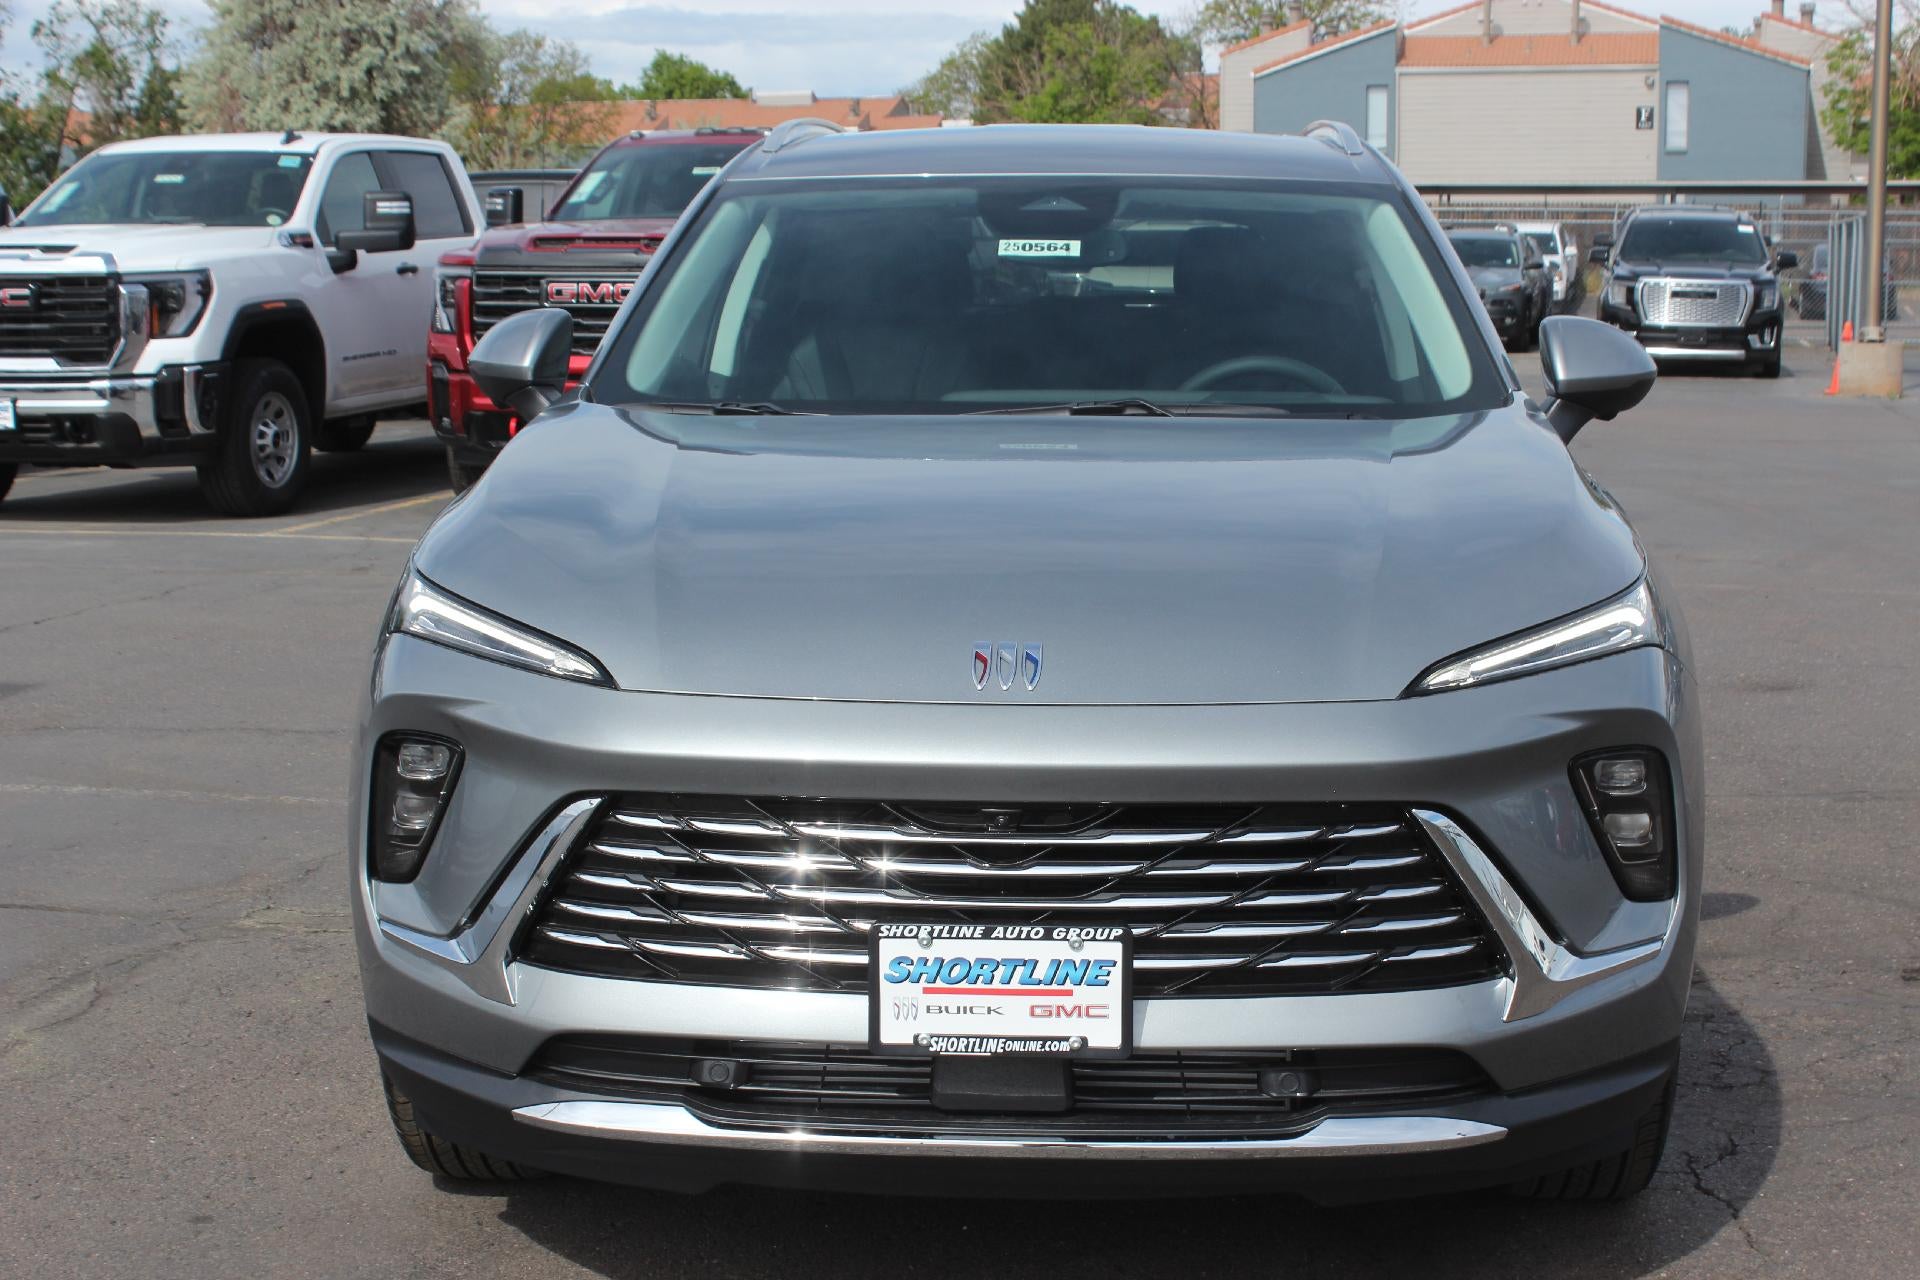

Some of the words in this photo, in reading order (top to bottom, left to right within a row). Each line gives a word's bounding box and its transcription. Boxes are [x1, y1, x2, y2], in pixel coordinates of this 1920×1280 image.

[1003, 242, 1071, 252] 250564
[547, 282, 635, 303] GMC
[878, 925, 985, 939] SHORTLINE
[990, 926, 1044, 940] AUTO
[1052, 927, 1124, 941] GROUP
[883, 955, 1118, 987] SHORTLINE
[925, 1004, 1006, 1016] BUICK
[1029, 1003, 1110, 1019] GMC
